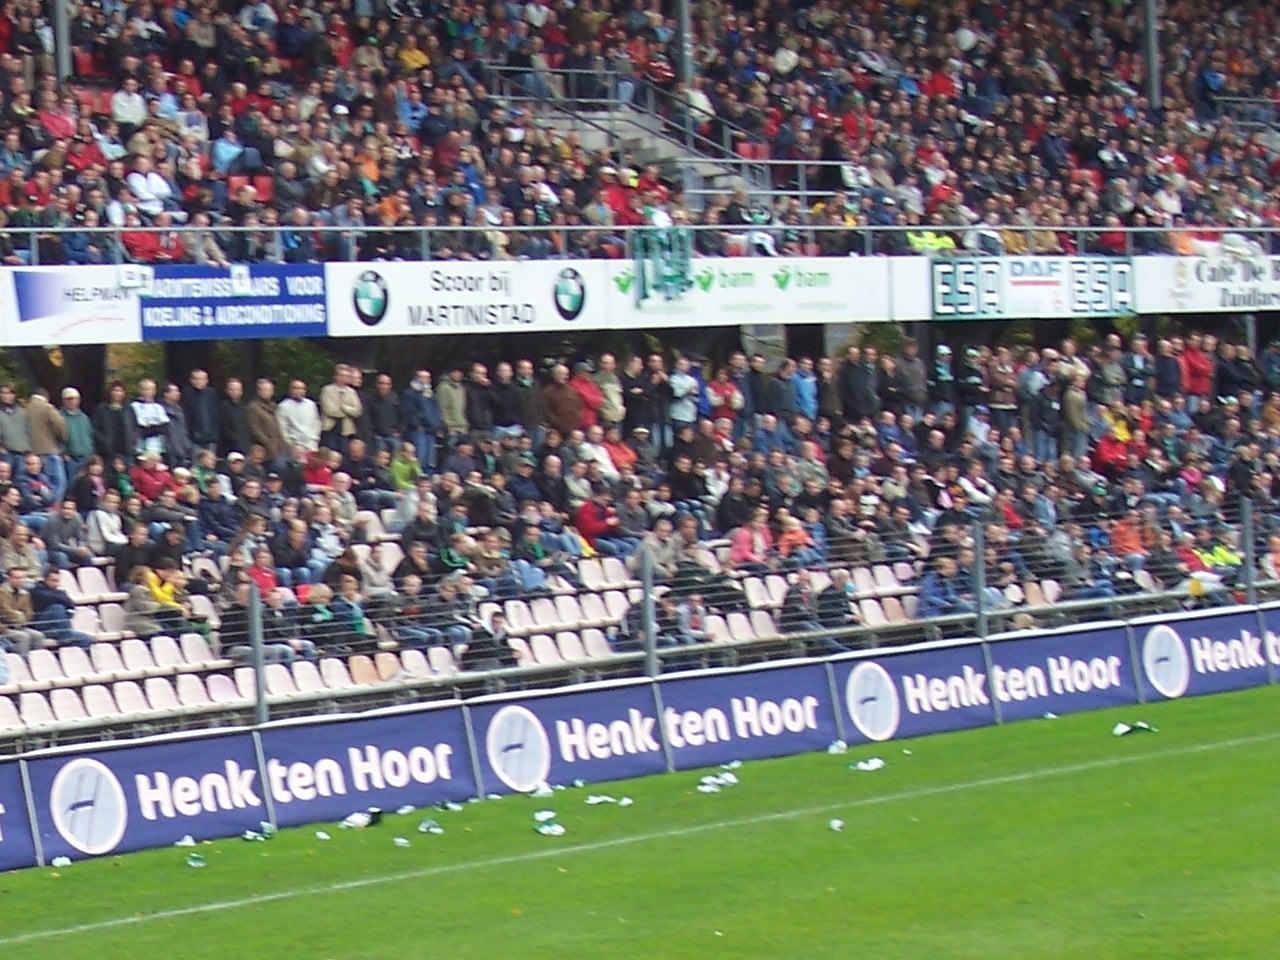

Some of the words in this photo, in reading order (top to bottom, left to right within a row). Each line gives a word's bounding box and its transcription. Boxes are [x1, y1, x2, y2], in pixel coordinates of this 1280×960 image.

[429, 270, 484, 292] Scoor
[488, 270, 512, 297] bij
[1010, 260, 1061, 277] DAF
[406, 303, 536, 327] MARTINISTAD
[1190, 628, 1266, 674] Henk
[901, 665, 989, 715] Henk
[992, 663, 1049, 702] ten
[1046, 655, 1122, 695] Hoor
[555, 707, 661, 763] Henk
[663, 705, 730, 747] ten
[730, 695, 819, 739] Hoor
[134, 759, 262, 821] Henk
[267, 757, 346, 804] ten
[347, 743, 453, 792] Hoor
